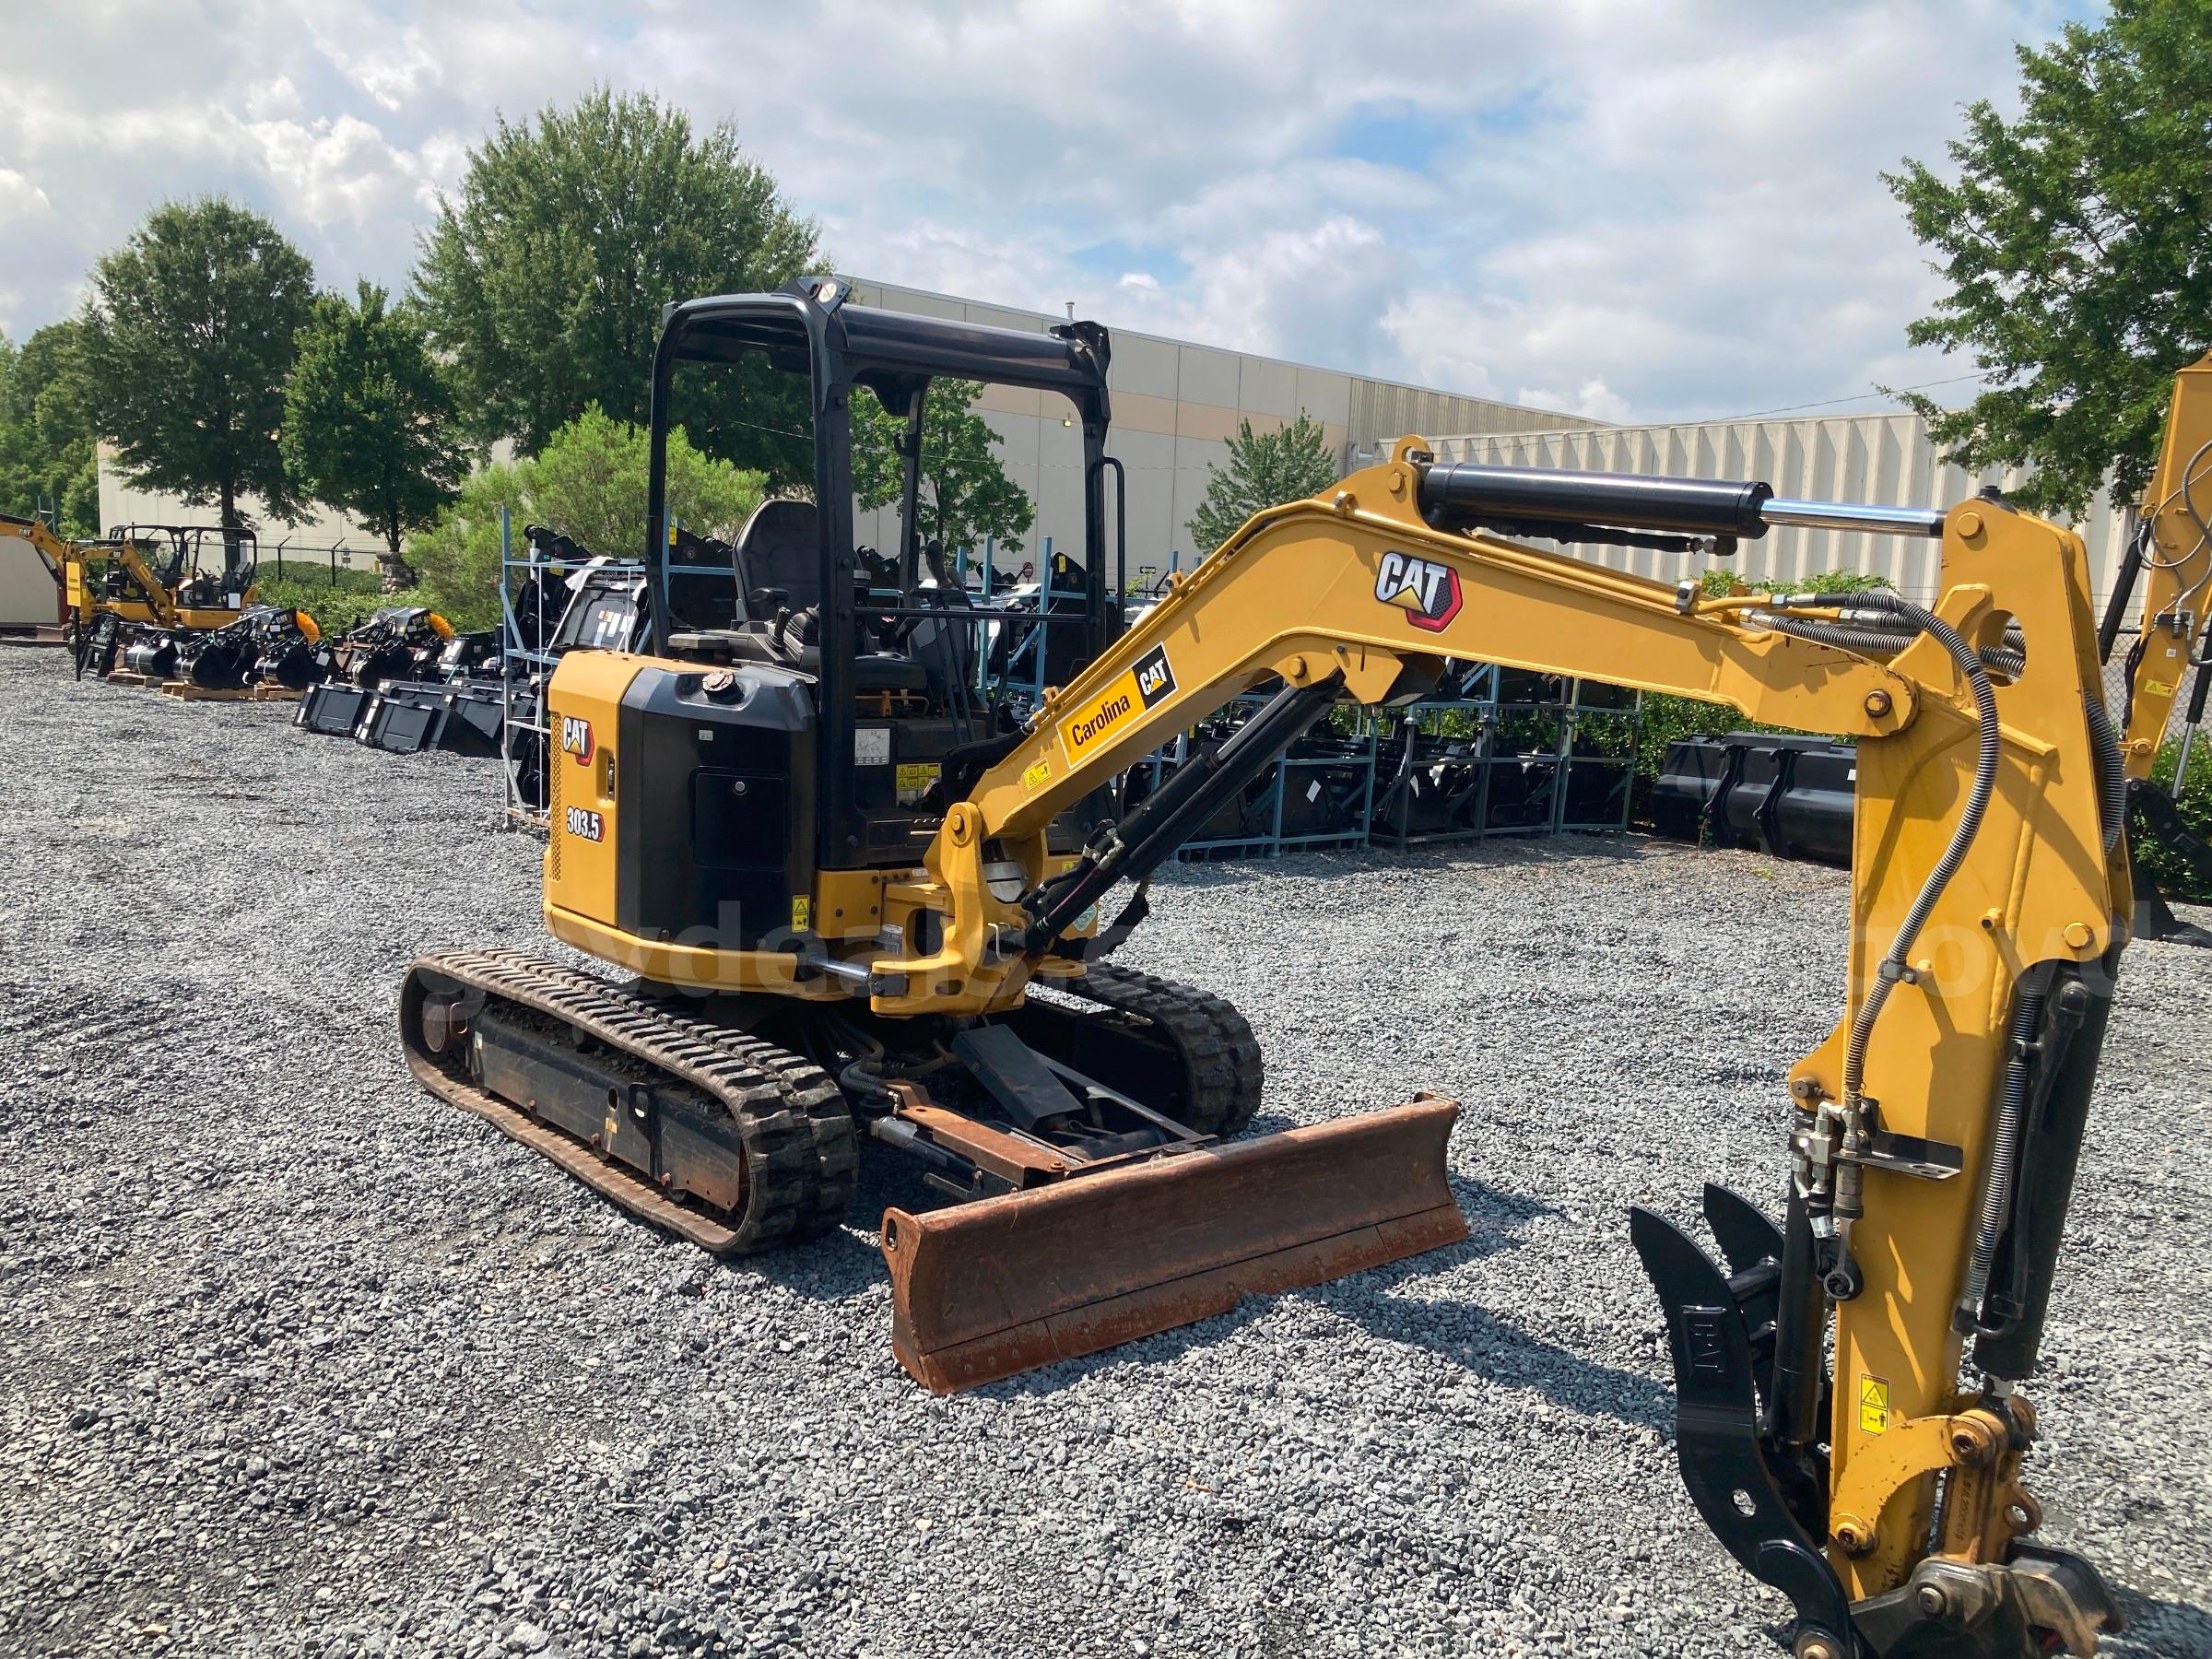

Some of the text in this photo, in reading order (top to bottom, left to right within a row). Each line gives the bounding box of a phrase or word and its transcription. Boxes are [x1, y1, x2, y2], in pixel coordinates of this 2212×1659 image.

[1376, 552, 1447, 615] CAT
[275, 614, 288, 625] CAT
[1072, 658, 1168, 747] Carolina CAT
[562, 717, 588, 756] CAT
[567, 806, 599, 841] 303.5
